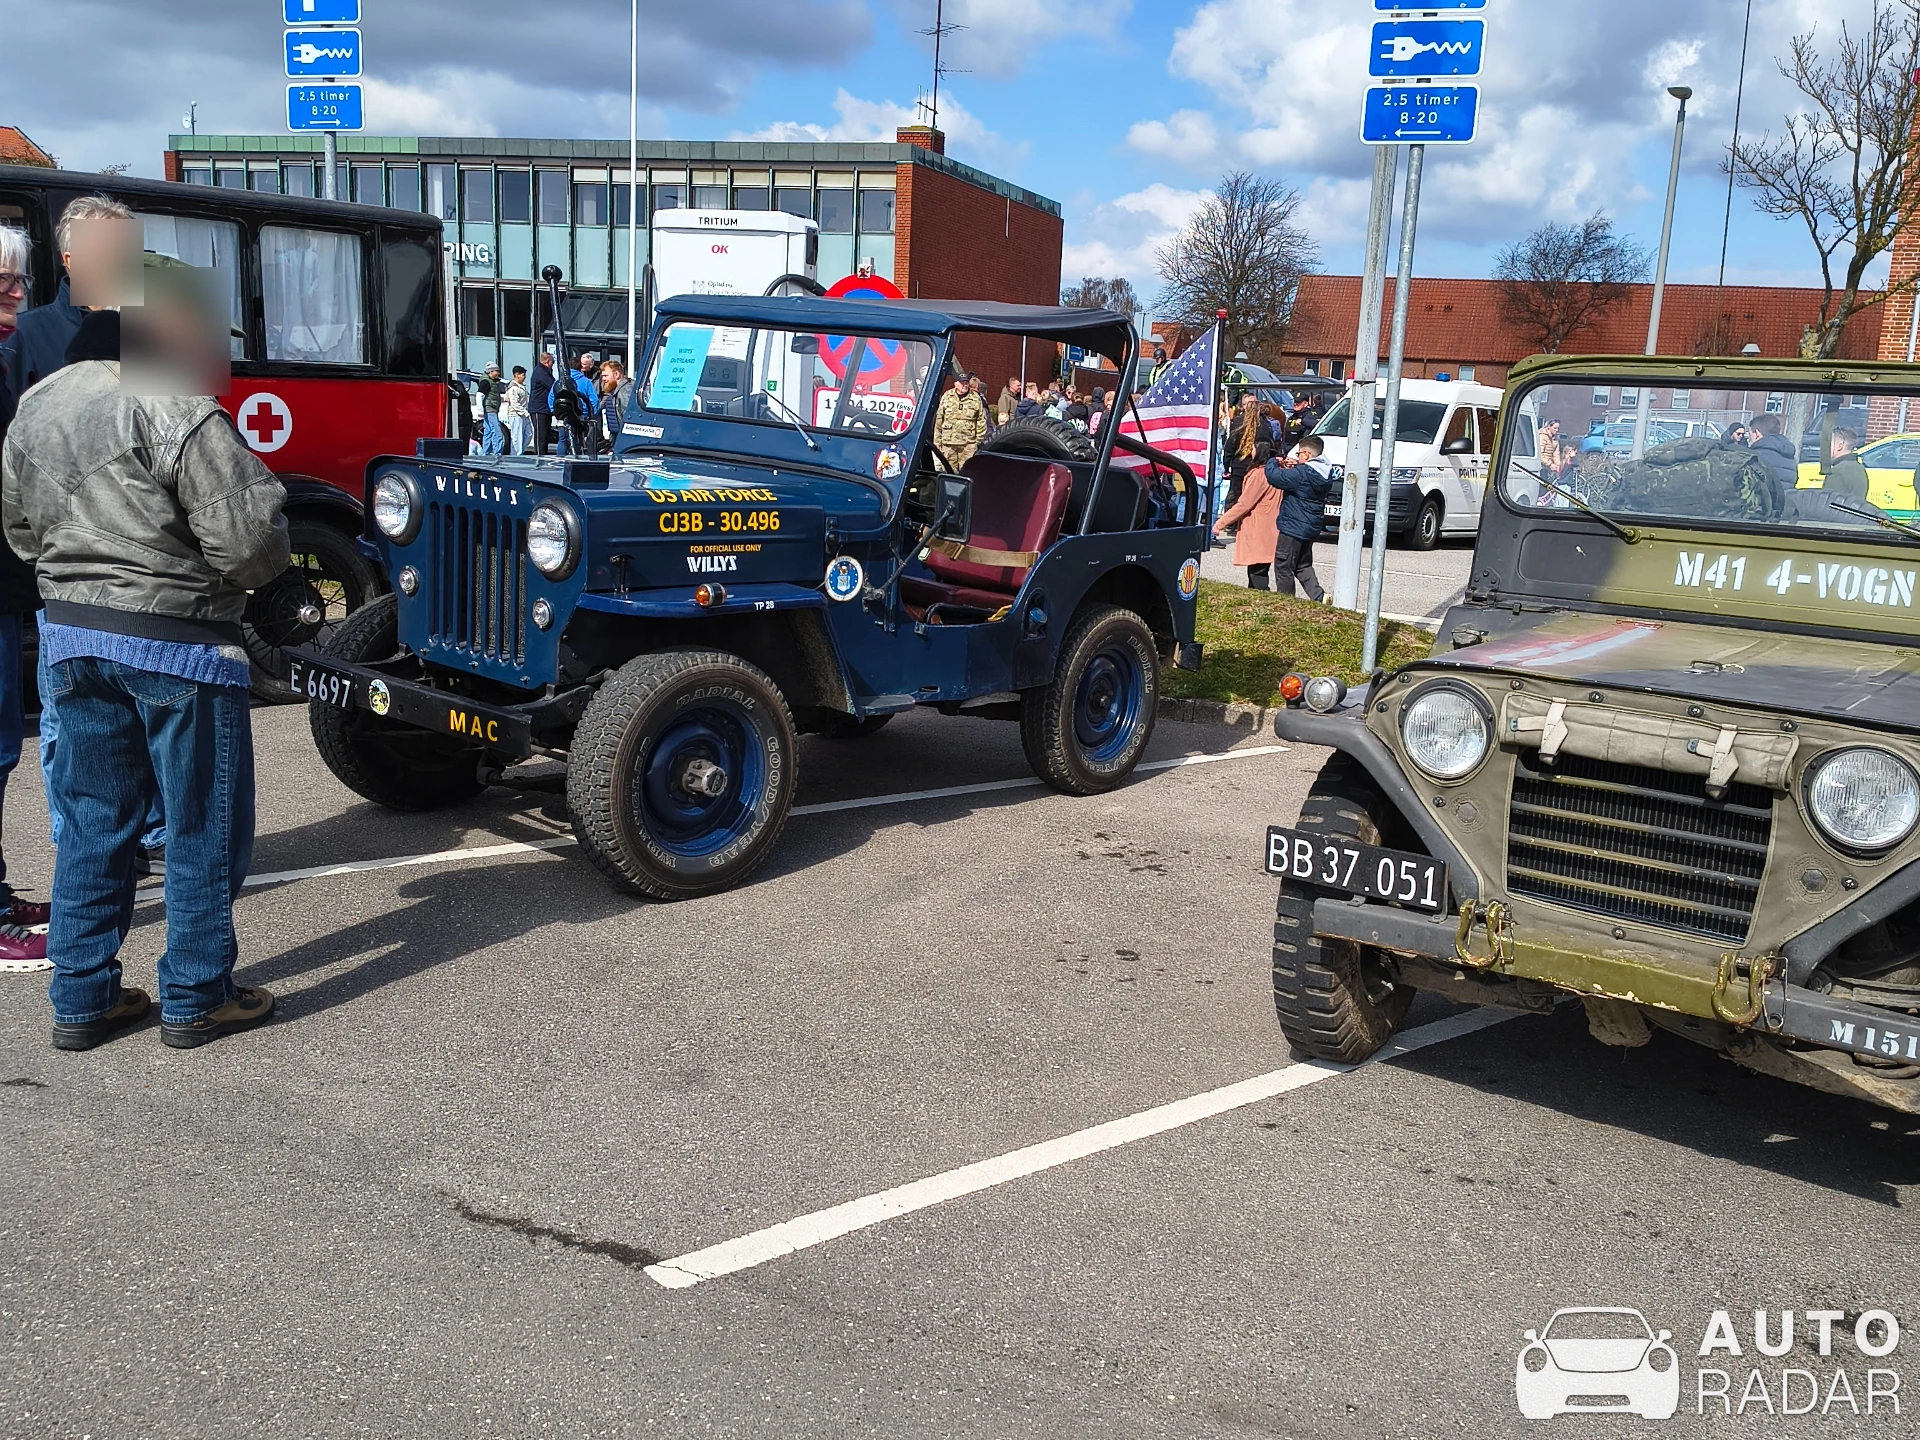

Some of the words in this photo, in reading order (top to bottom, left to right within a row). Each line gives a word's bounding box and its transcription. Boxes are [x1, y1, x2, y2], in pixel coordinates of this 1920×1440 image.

[299, 91, 316, 101] 2,5
[320, 90, 350, 101] timer
[1383, 93, 1408, 107] 2,5
[1415, 93, 1459, 105] timer
[698, 217, 738, 226] TRITIUM
[711, 244, 729, 254] OK
[769, 382, 776, 390] 2
[435, 475, 518, 506] WILLYS
[646, 488, 678, 503] US
[680, 488, 716, 502] AIR
[713, 488, 778, 502] FORCE
[659, 512, 704, 533] CJ3B
[720, 511, 780, 531] 30.496
[690, 545, 703, 553] FOR
[704, 545, 732, 553] OFFICIAL
[732, 544, 745, 552] USE
[745, 543, 762, 552] ONLY
[686, 555, 738, 573] WILLYS
[1675, 551, 1747, 590] M41
[1767, 559, 1916, 607] 4-VOGN
[754, 601, 764, 611] TP
[765, 600, 775, 610] 28
[307, 669, 351, 708] 6697
[675, 686, 756, 711] RADIAL
[449, 709, 499, 742] MAC
